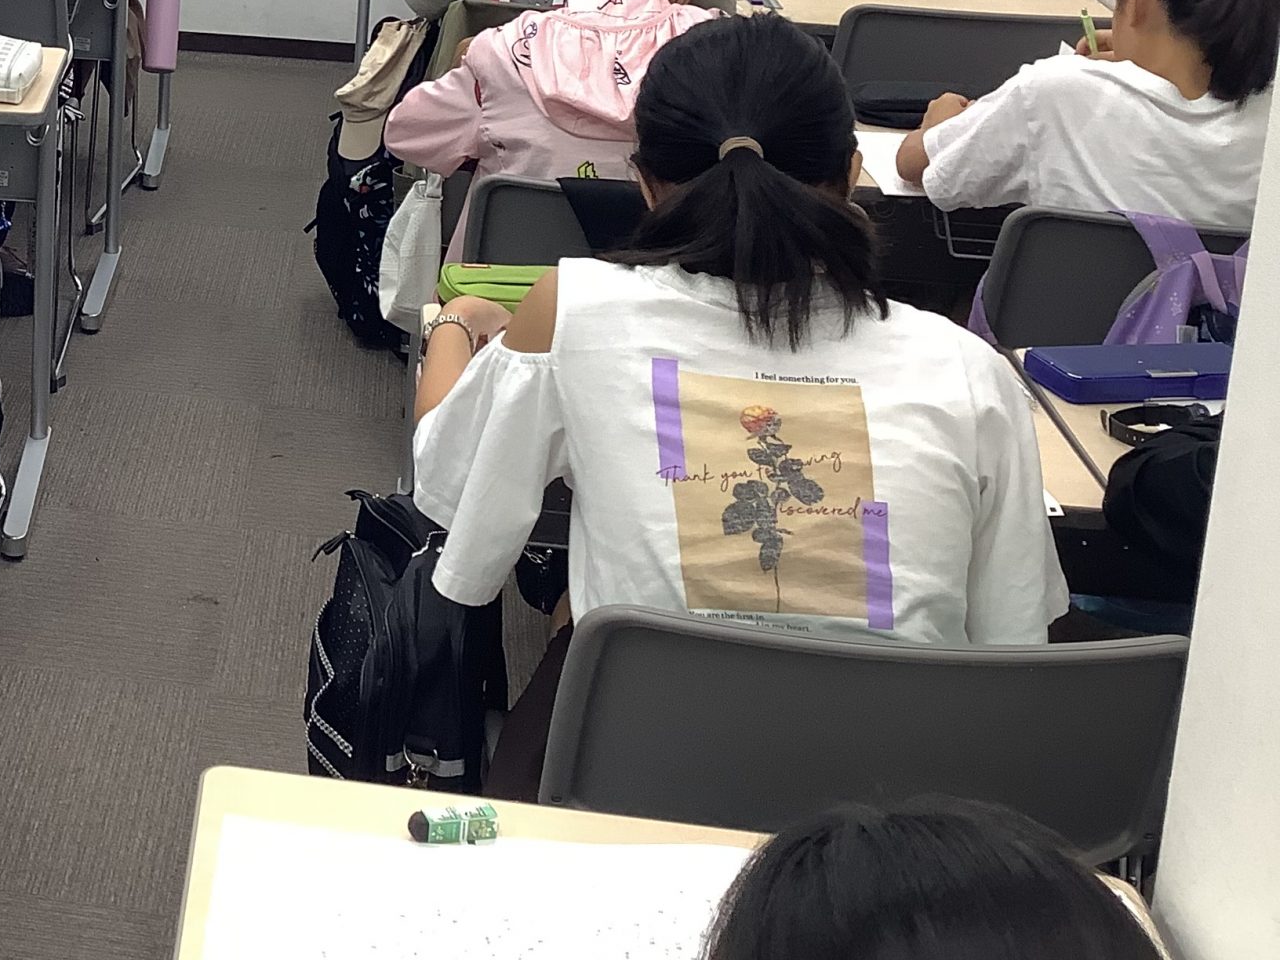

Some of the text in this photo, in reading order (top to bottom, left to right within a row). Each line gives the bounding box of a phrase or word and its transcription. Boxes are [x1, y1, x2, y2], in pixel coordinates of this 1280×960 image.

[761, 373, 776, 381] feel
[779, 375, 825, 384] something
[656, 463, 714, 486] Thank
[720, 470, 753, 491] you
[862, 506, 888, 519] me
